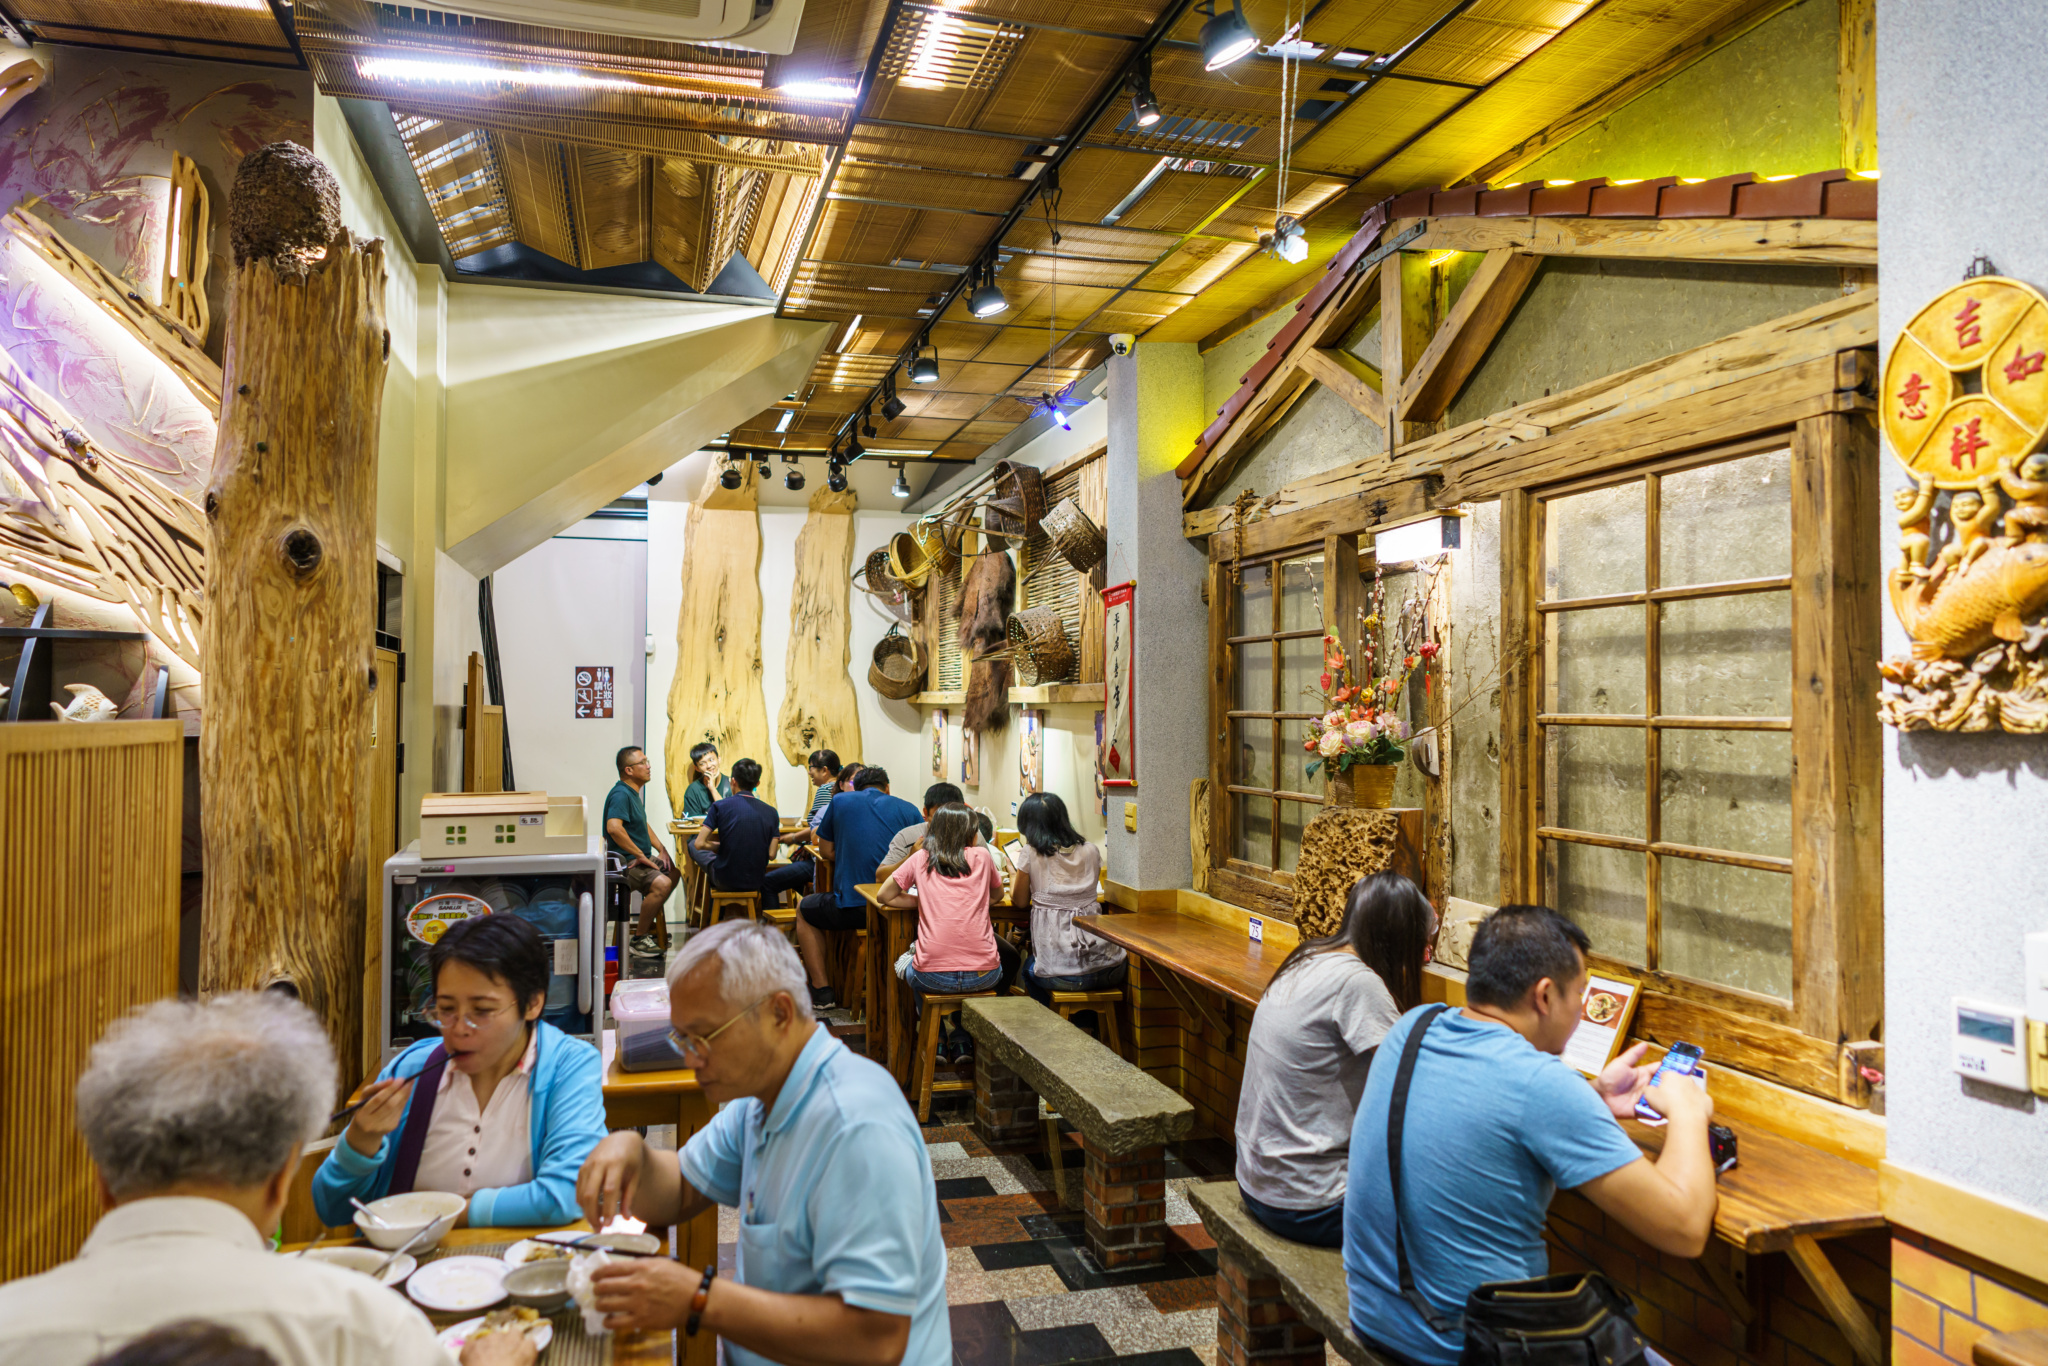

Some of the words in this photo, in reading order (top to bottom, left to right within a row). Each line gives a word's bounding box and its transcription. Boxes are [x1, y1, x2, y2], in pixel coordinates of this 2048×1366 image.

[1954, 297, 1982, 349] 吉
[2003, 344, 2046, 384] 如
[1896, 372, 1931, 420] 意
[1950, 416, 1990, 470] 祥
[1251, 924, 1260, 938] 75
